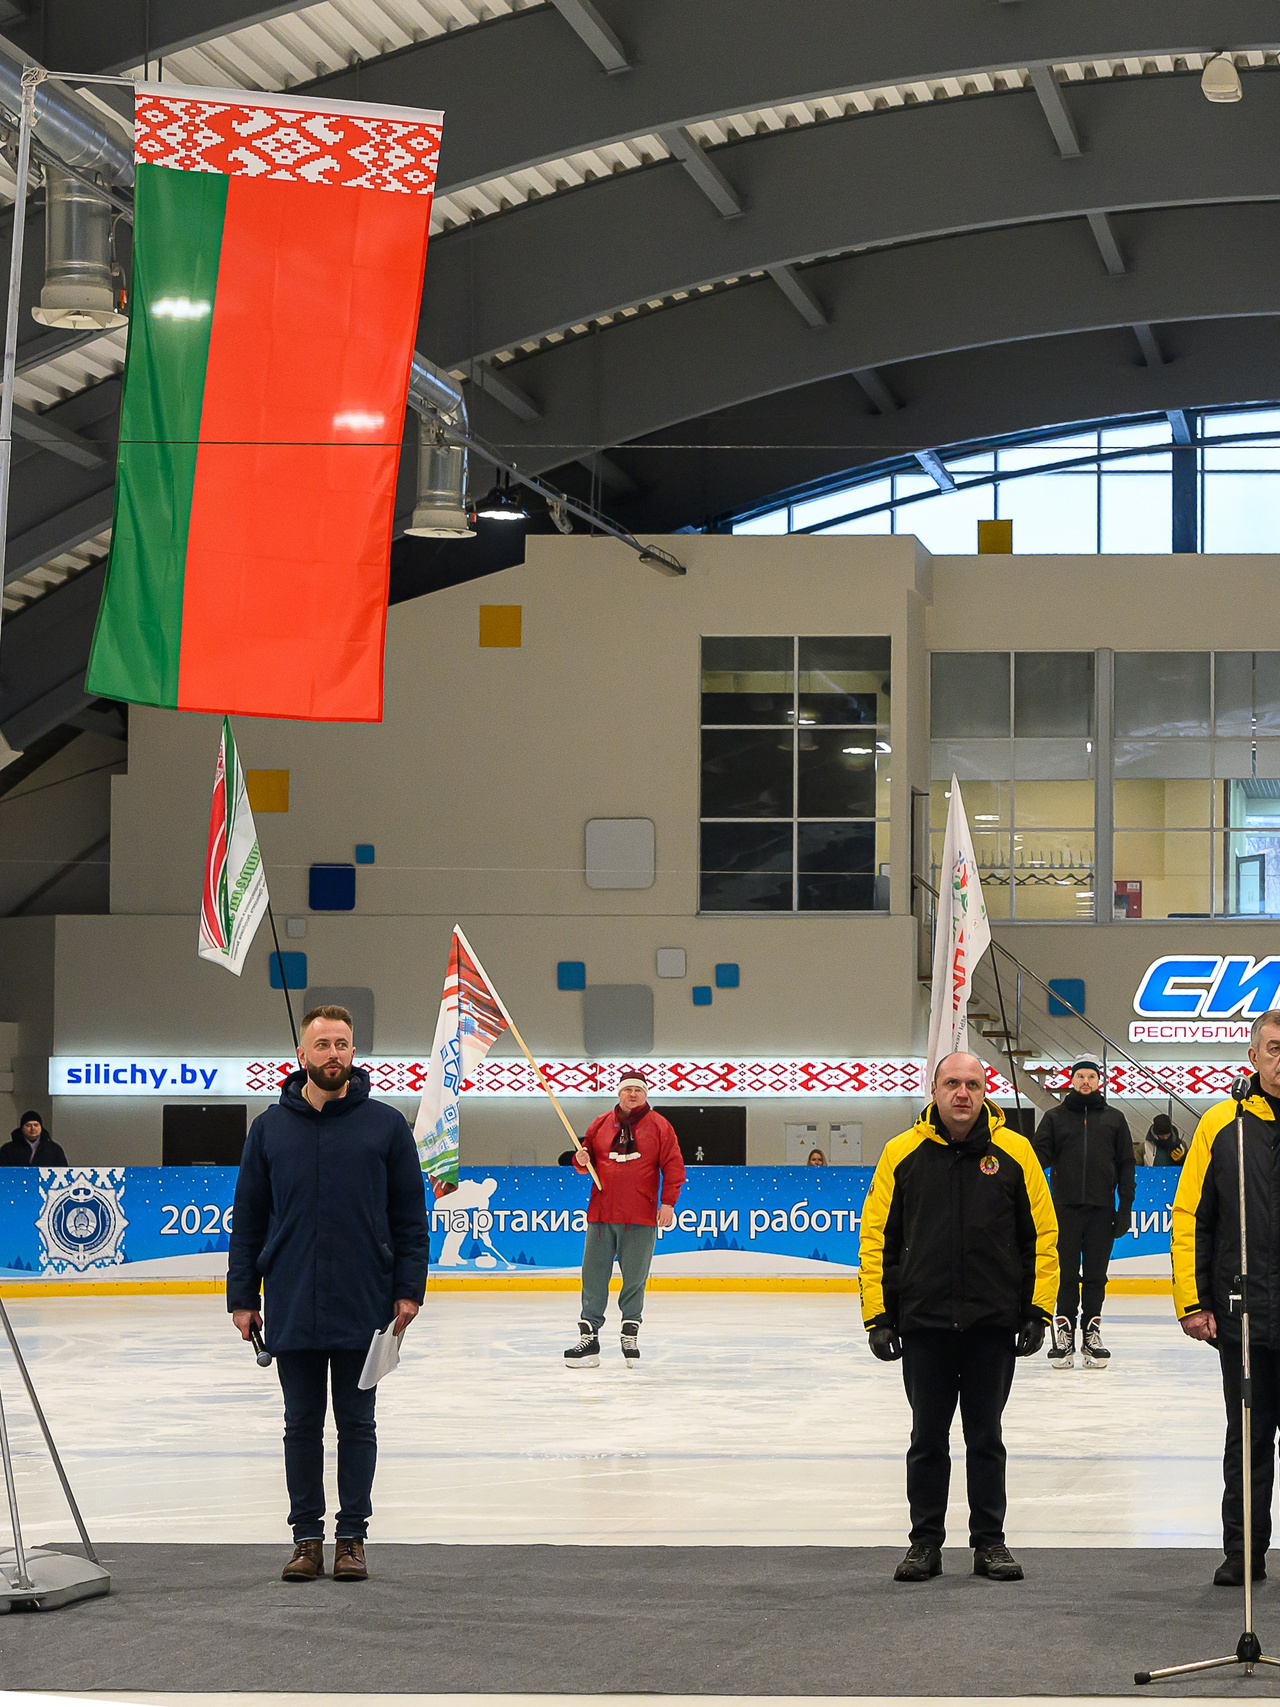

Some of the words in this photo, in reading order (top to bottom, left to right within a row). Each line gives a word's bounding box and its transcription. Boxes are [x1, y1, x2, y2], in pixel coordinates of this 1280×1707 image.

[67, 1063, 219, 1090] silichy.by
[160, 1204, 234, 1234] 2026
[427, 1208, 588, 1239] партакиа
[656, 1208, 739, 1240] реди
[749, 1200, 864, 1240] работн
